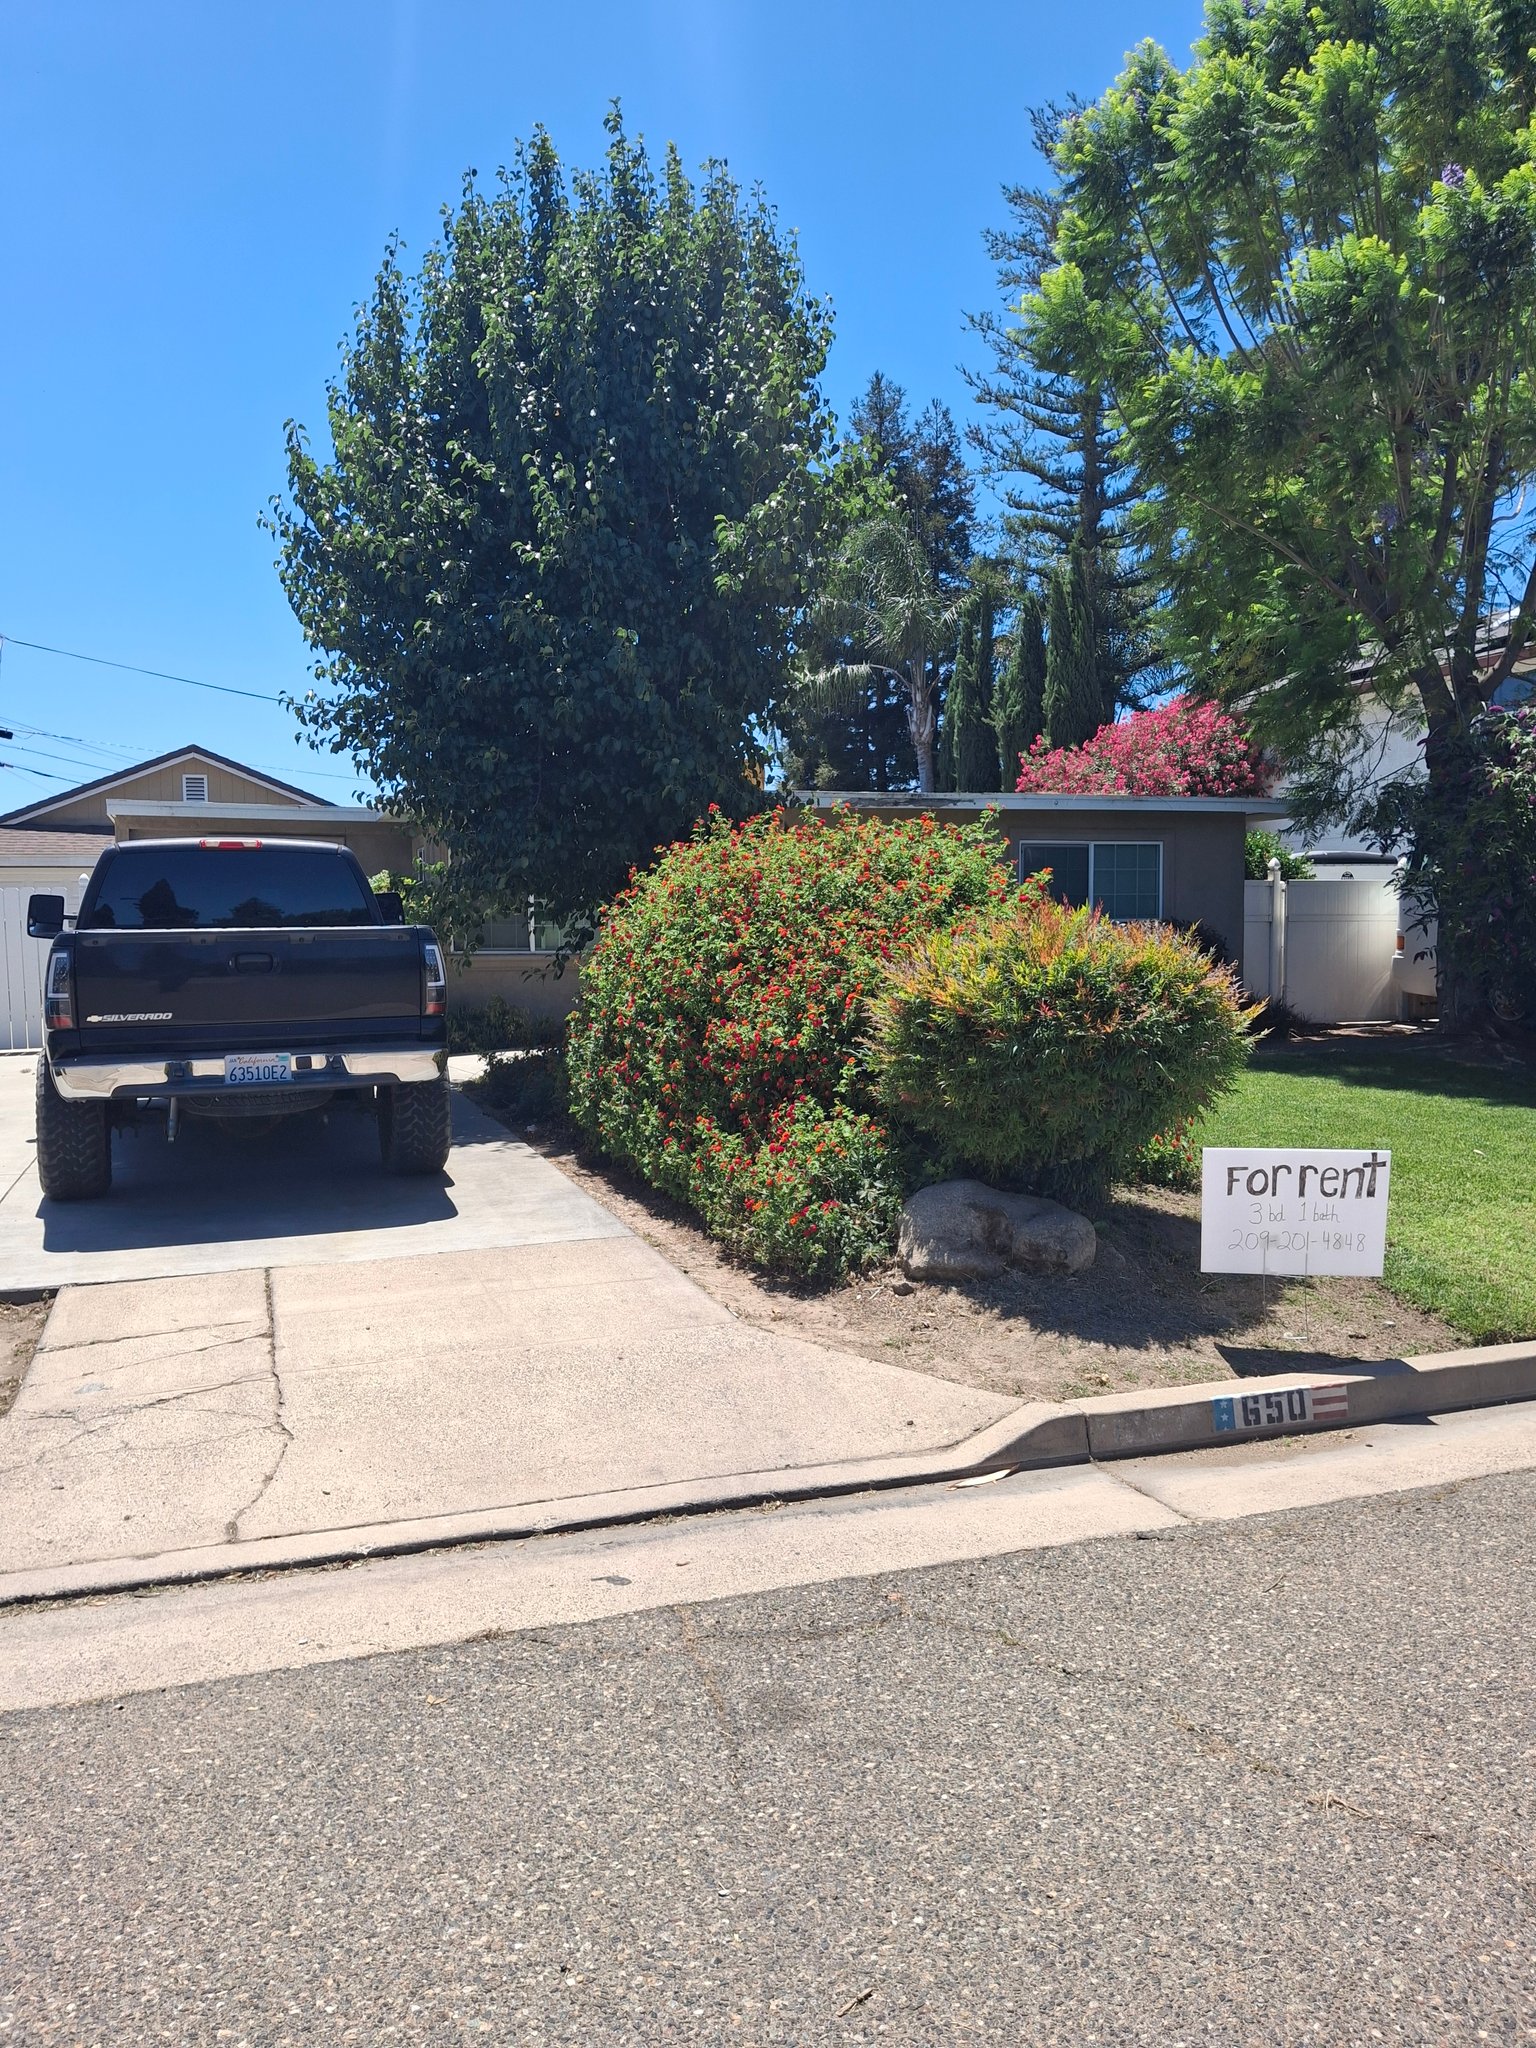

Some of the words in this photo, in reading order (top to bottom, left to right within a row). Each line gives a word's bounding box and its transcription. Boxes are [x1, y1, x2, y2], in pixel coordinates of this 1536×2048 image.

[101, 1012, 173, 1022] SILVERADO
[238, 1055, 276, 1066] California
[229, 1065, 287, 1082] 63510E2
[1226, 1164, 1292, 1197] For
[1298, 1152, 1387, 1199] rent
[1248, 1202, 1263, 1225] 3
[1268, 1203, 1286, 1222] bd
[1298, 1202, 1306, 1222] 1
[1312, 1202, 1341, 1223] bath
[1227, 1228, 1367, 1252] 209-201-4848
[1241, 1387, 1307, 1427] 650
